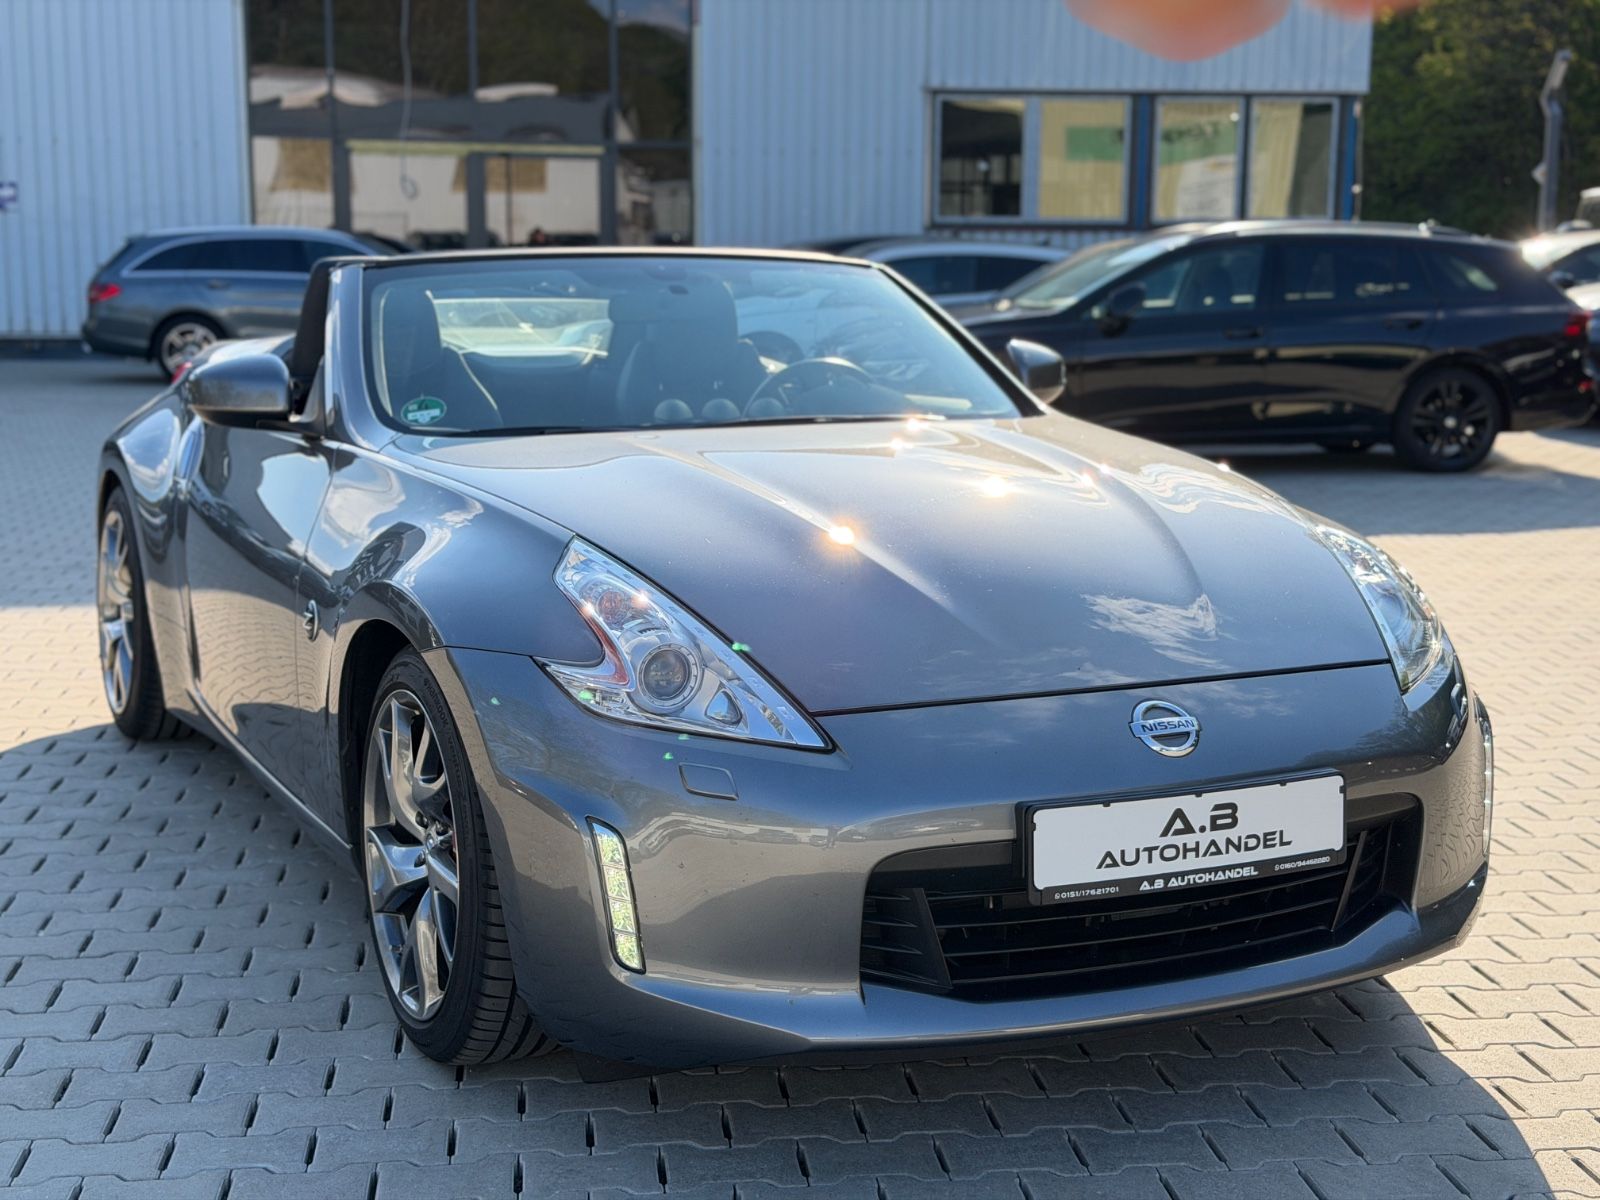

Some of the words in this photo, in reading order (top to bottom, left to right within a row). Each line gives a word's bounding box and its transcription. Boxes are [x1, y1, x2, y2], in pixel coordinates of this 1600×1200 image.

[1141, 719, 1195, 733] NISSAN
[1159, 802, 1239, 838] A.B
[1096, 829, 1293, 869] AUTOHANDEL
[1139, 878, 1165, 891] A.B
[1167, 866, 1259, 888] AUTOHANDEL
[1061, 886, 1120, 899] 0151/17621701
